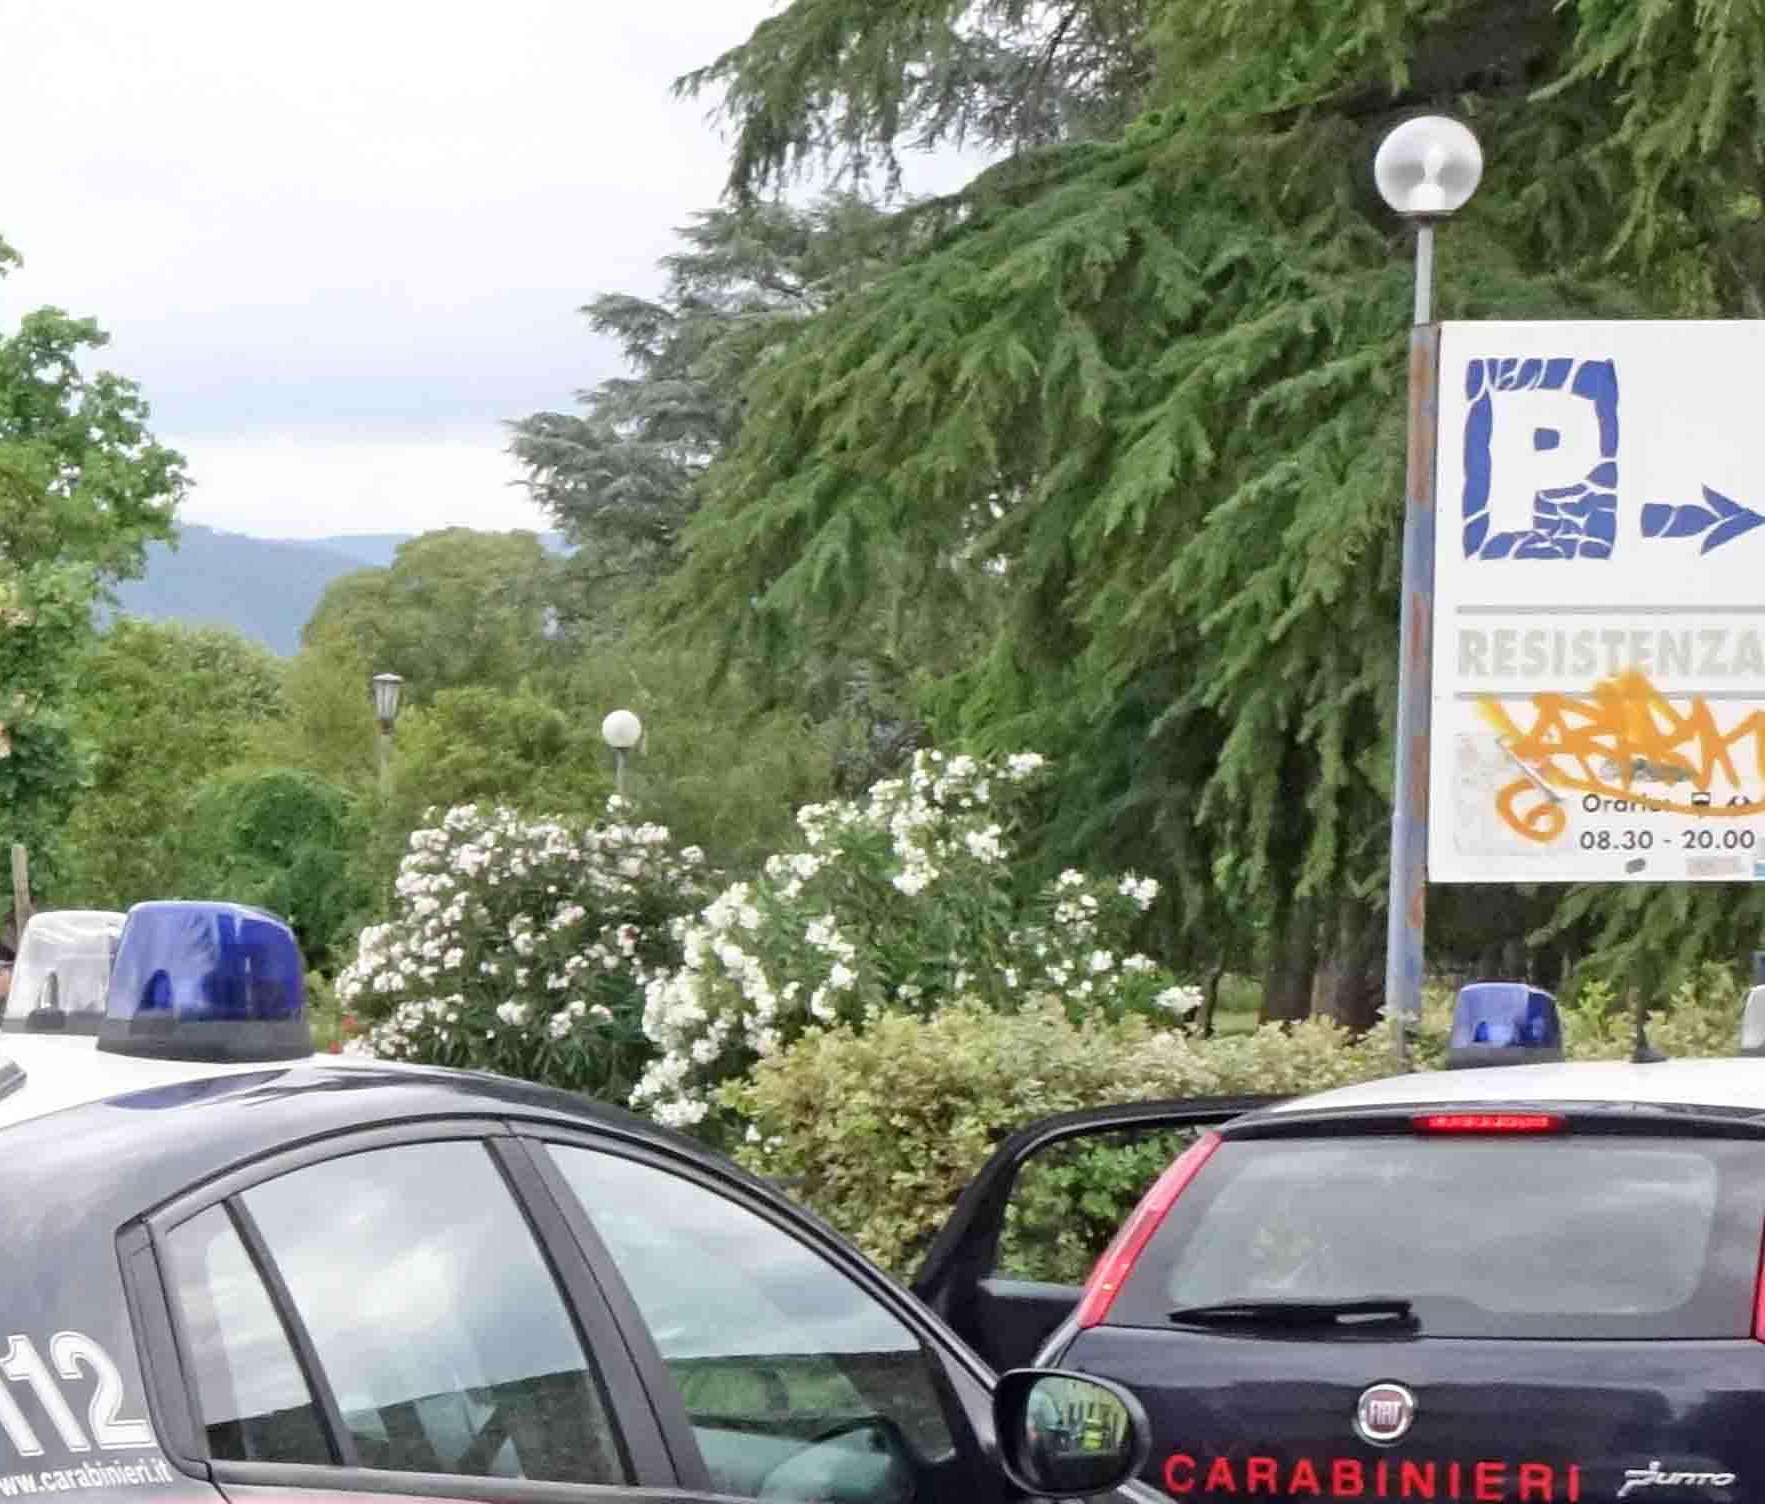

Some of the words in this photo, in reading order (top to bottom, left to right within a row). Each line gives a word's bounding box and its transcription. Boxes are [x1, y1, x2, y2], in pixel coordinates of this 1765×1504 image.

[1457, 628, 1765, 677] RESISTENZA
[1580, 829, 1654, 850] 08.30
[1681, 829, 1756, 850] 20.00
[1165, 1454, 1581, 1503] CARABINIERI
